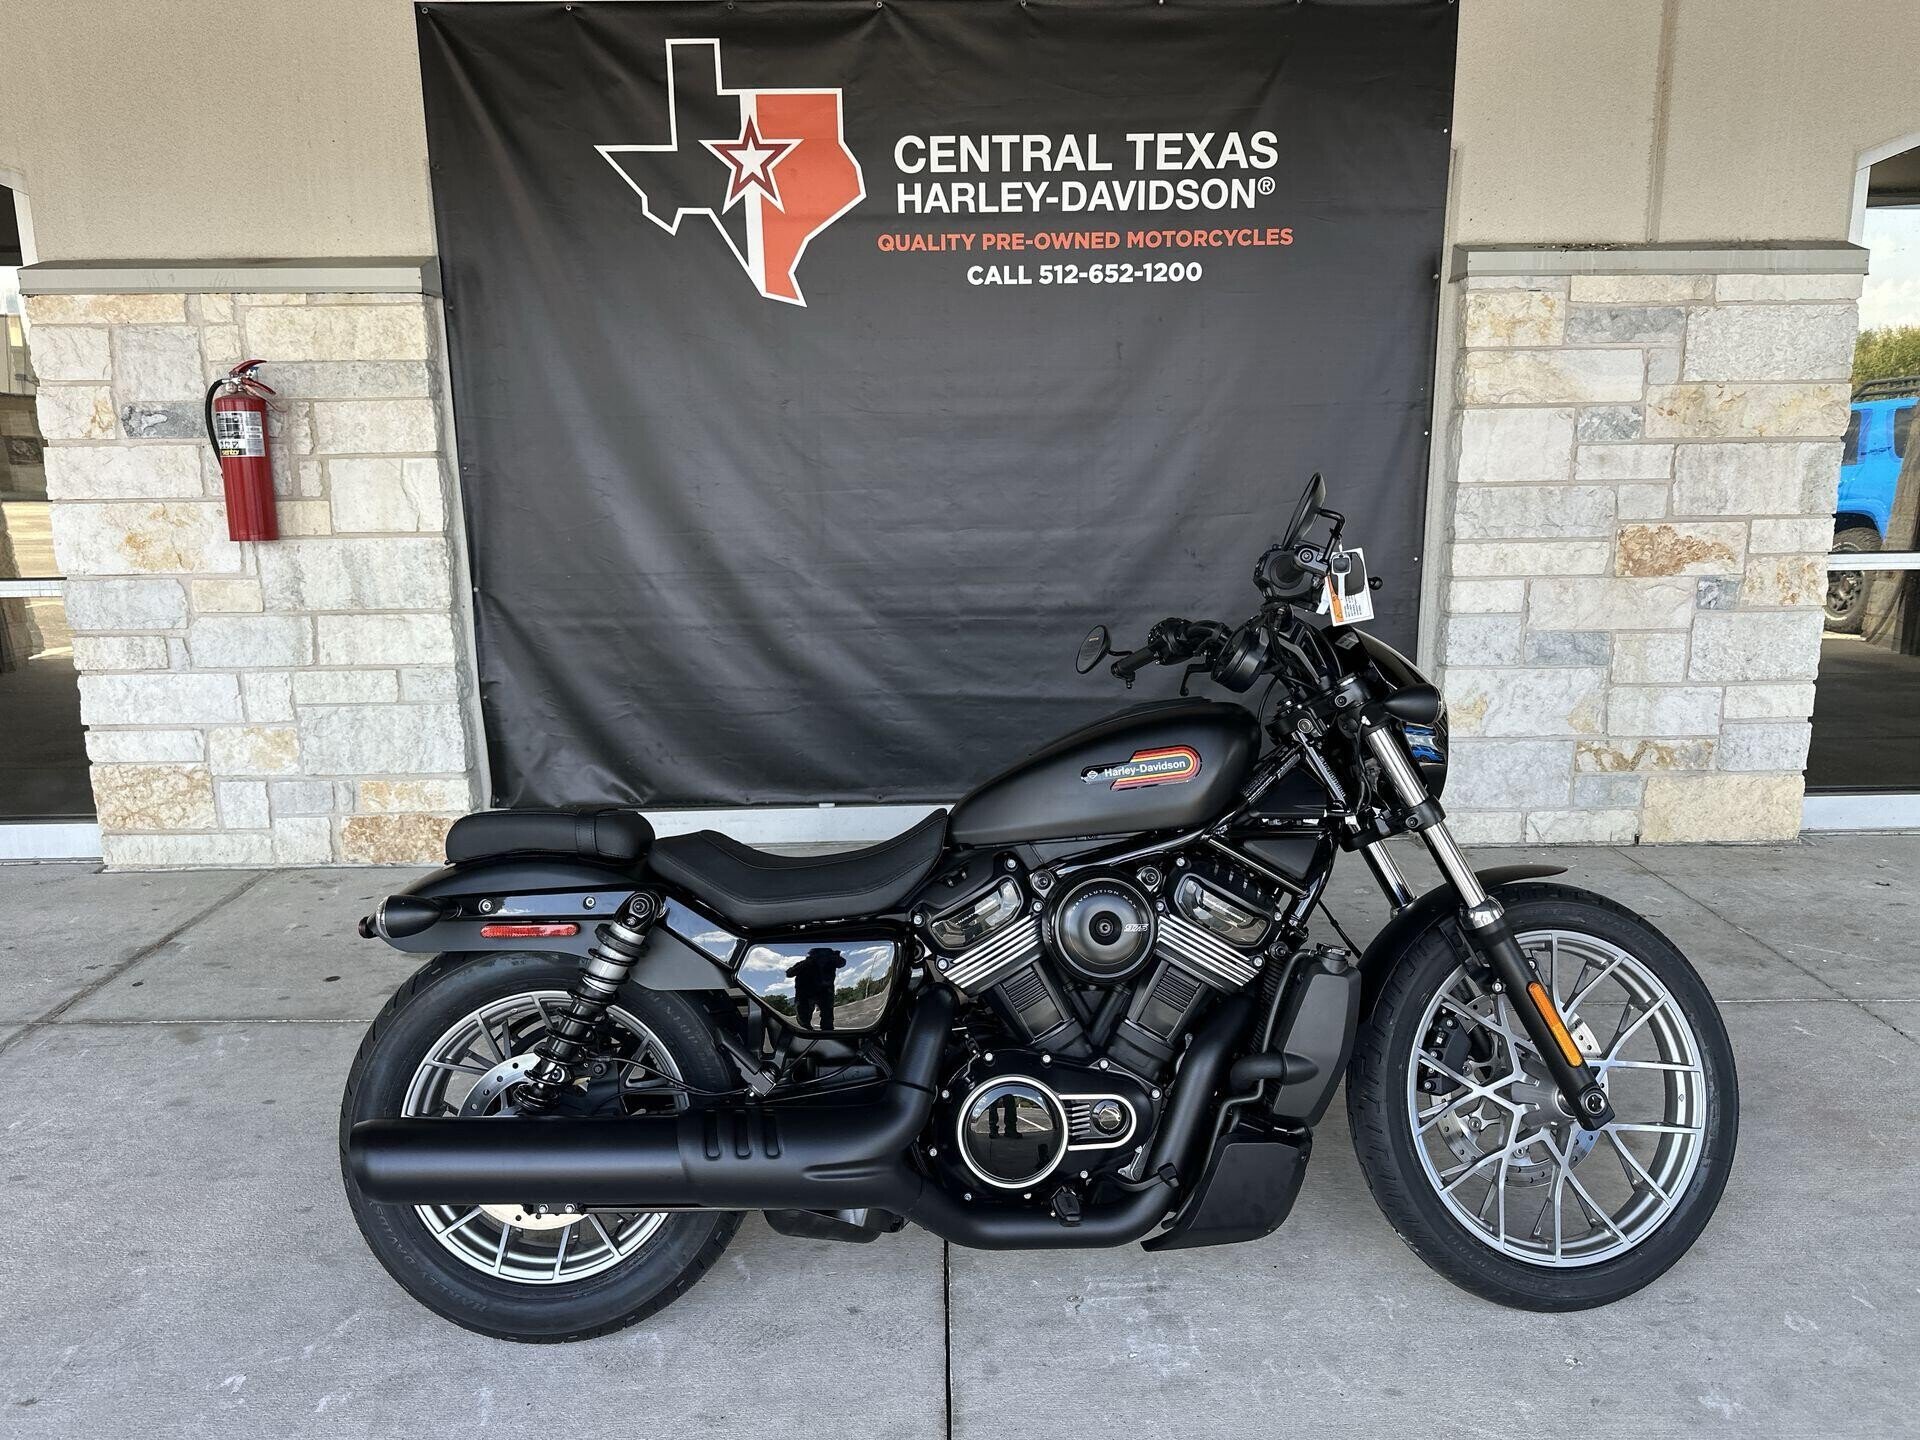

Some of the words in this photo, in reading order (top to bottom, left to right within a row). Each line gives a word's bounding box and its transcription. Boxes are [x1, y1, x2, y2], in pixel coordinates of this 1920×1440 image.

[895, 134, 1112, 173] CENTRAL
[1126, 131, 1278, 170] TEXAS
[878, 234, 976, 251] QUALITY
[983, 232, 1120, 250] PRE-OWNED
[1128, 228, 1293, 248] MOTORCYCLES
[967, 265, 1032, 285] CALL
[1039, 262, 1202, 284] 512-652-1200
[1104, 760, 1186, 777] Harley-Davidson
